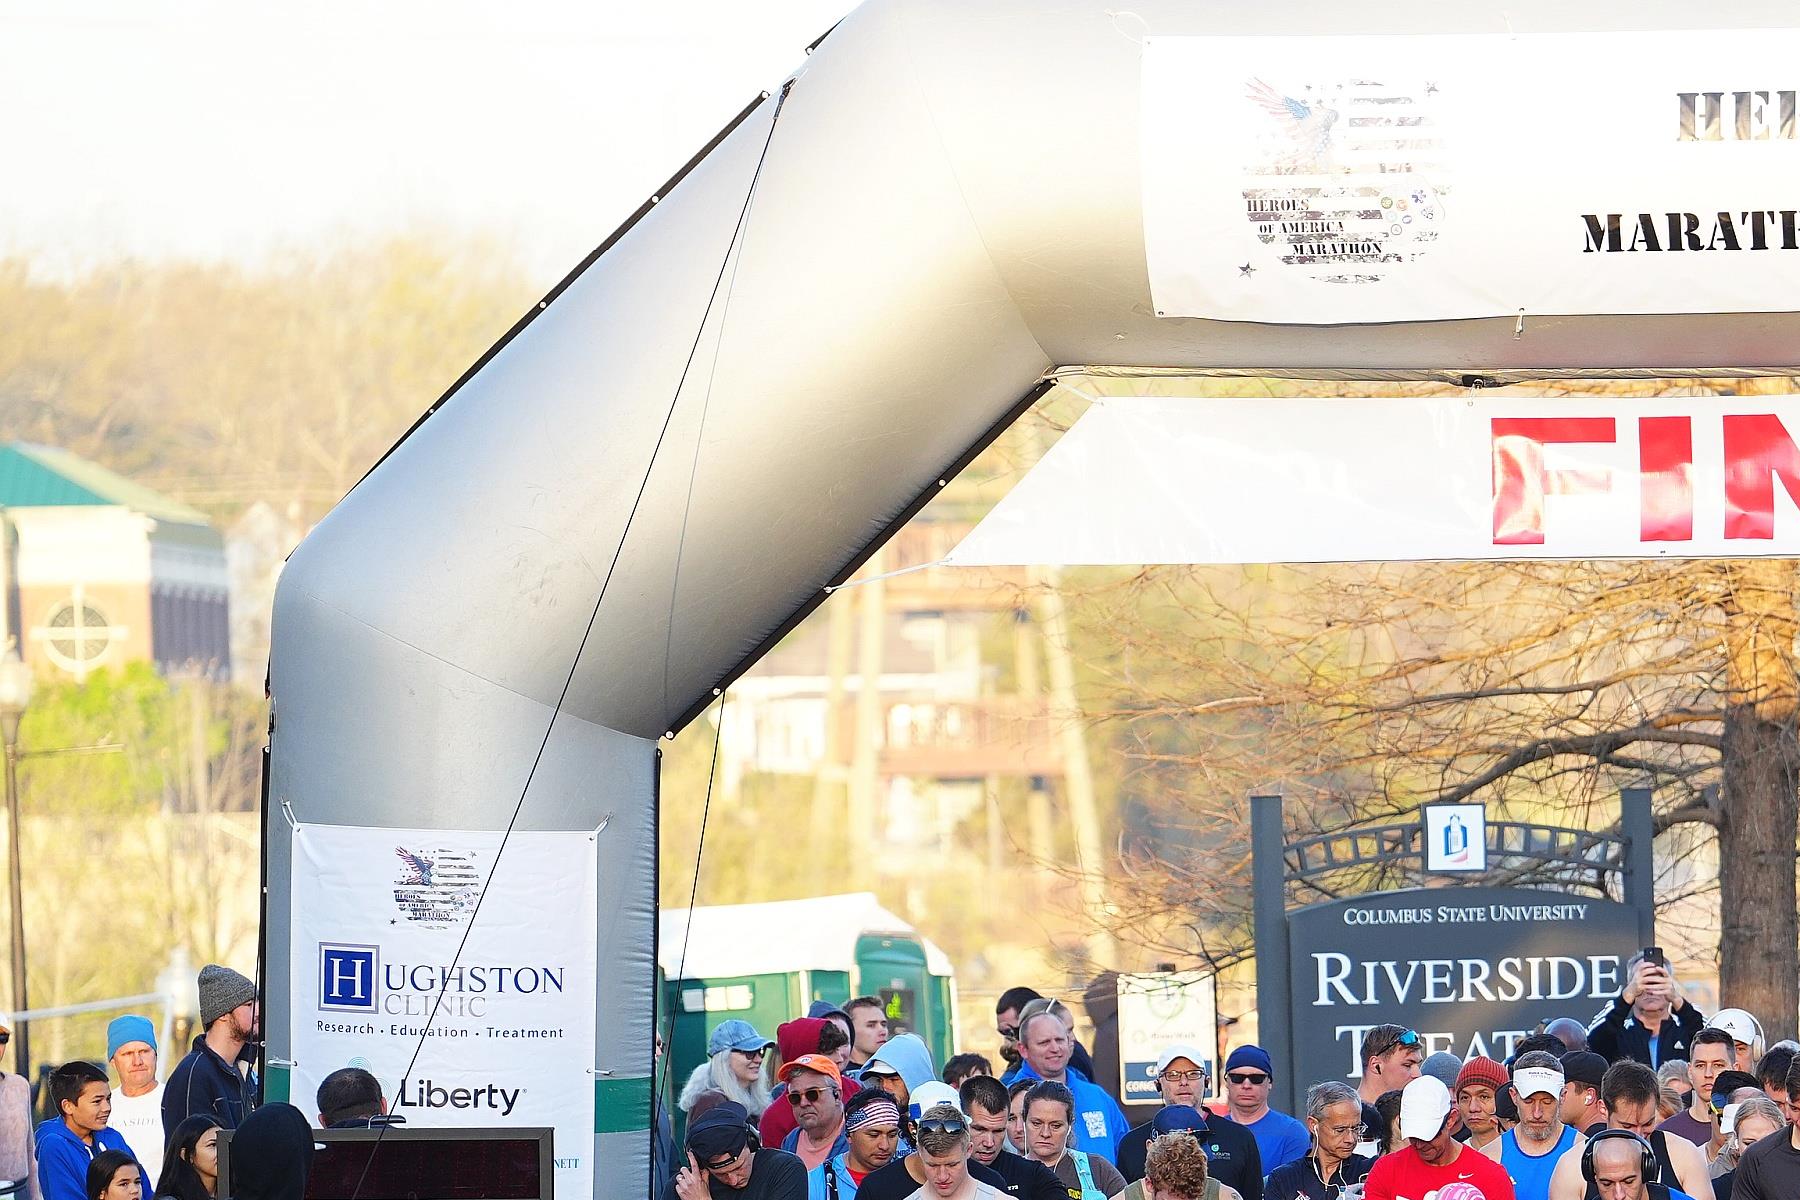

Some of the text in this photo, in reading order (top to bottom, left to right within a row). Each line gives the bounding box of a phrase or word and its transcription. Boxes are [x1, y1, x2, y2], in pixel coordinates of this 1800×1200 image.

[1247, 199, 1310, 212] HEROES
[1259, 222, 1345, 233] OF AMERICA
[1293, 243, 1383, 255] MARATHON
[1343, 903, 1588, 926] COLUMBUS STATE UNIVERSITY
[1311, 952, 1622, 1007] RIVERSIDE
[384, 994, 487, 1018] CLINIC
[317, 1020, 564, 1039] Research Education Treatment
[400, 1079, 521, 1117] Liberty
